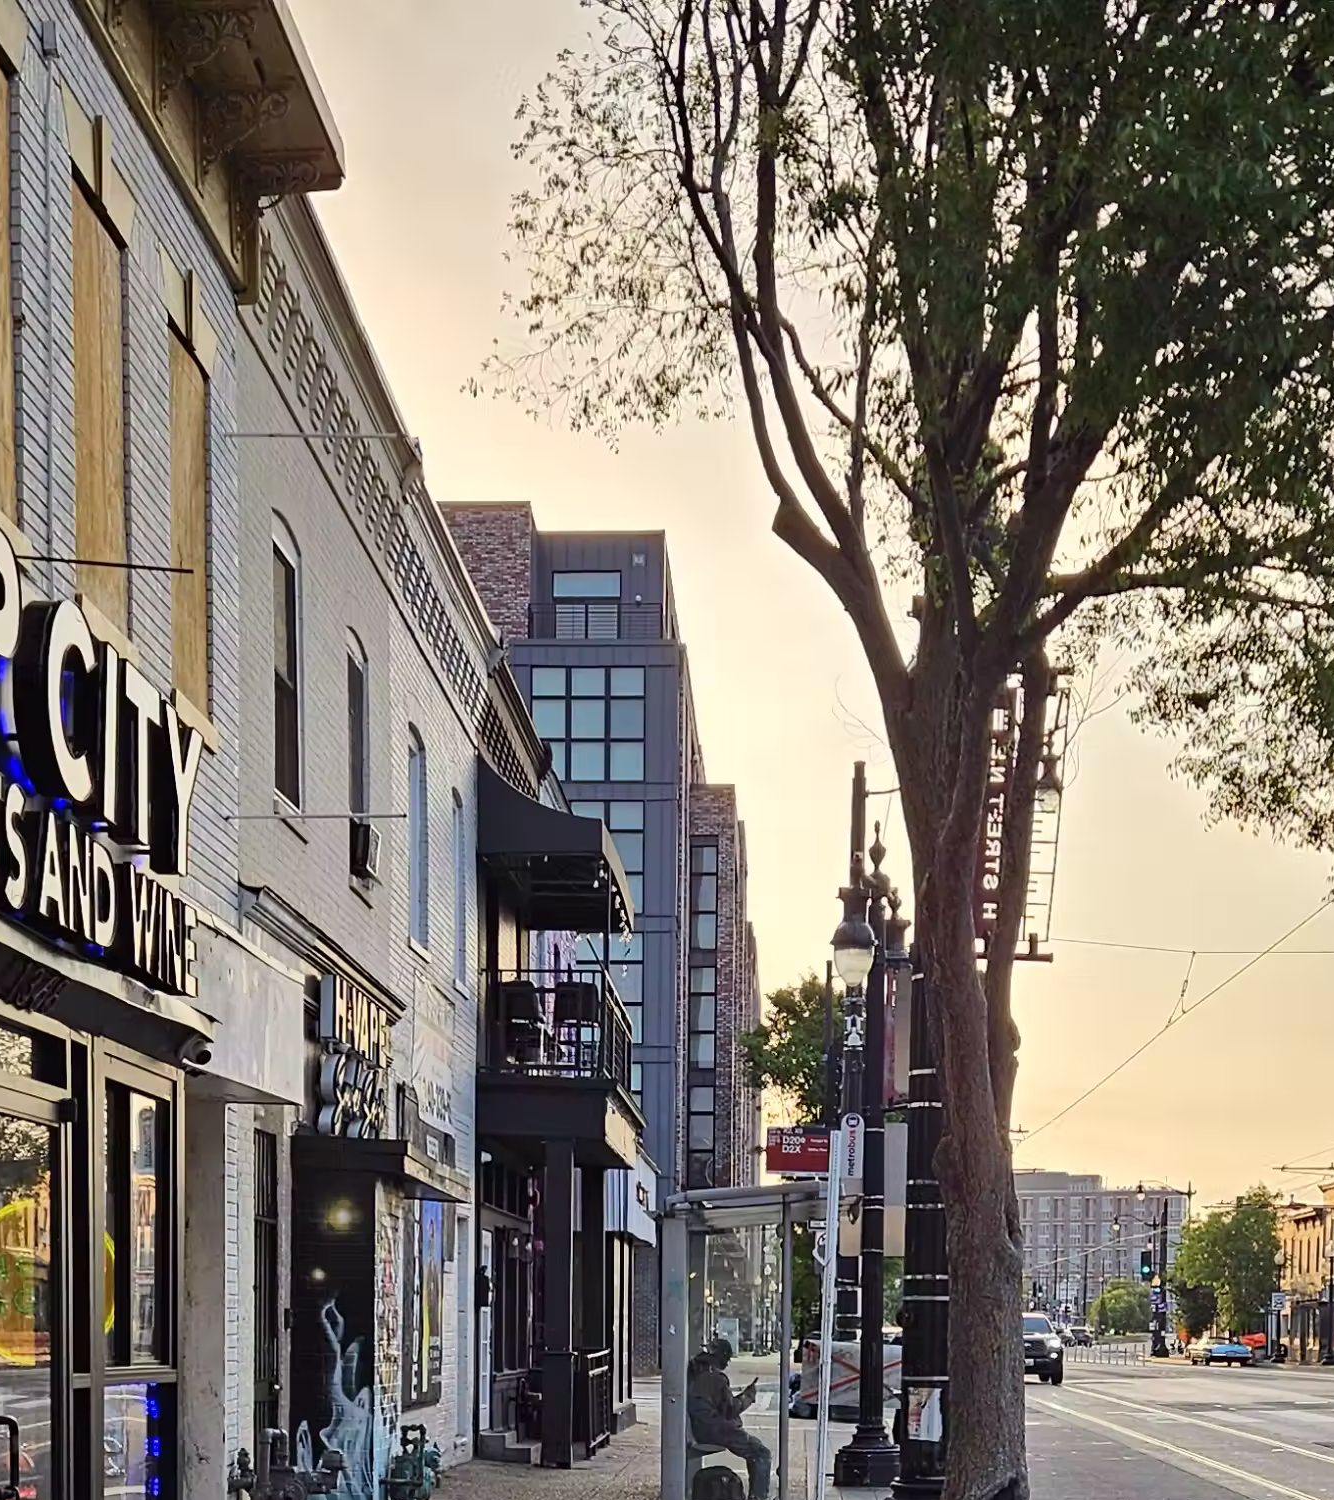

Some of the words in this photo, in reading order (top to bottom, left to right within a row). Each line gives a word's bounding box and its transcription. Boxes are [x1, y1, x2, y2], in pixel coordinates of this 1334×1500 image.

[45, 598, 204, 878] CITY
[39, 812, 116, 947] AND
[130, 860, 197, 998] WINE
[353, 987, 386, 1069] VAPE
[848, 1128, 857, 1176] metrobus
